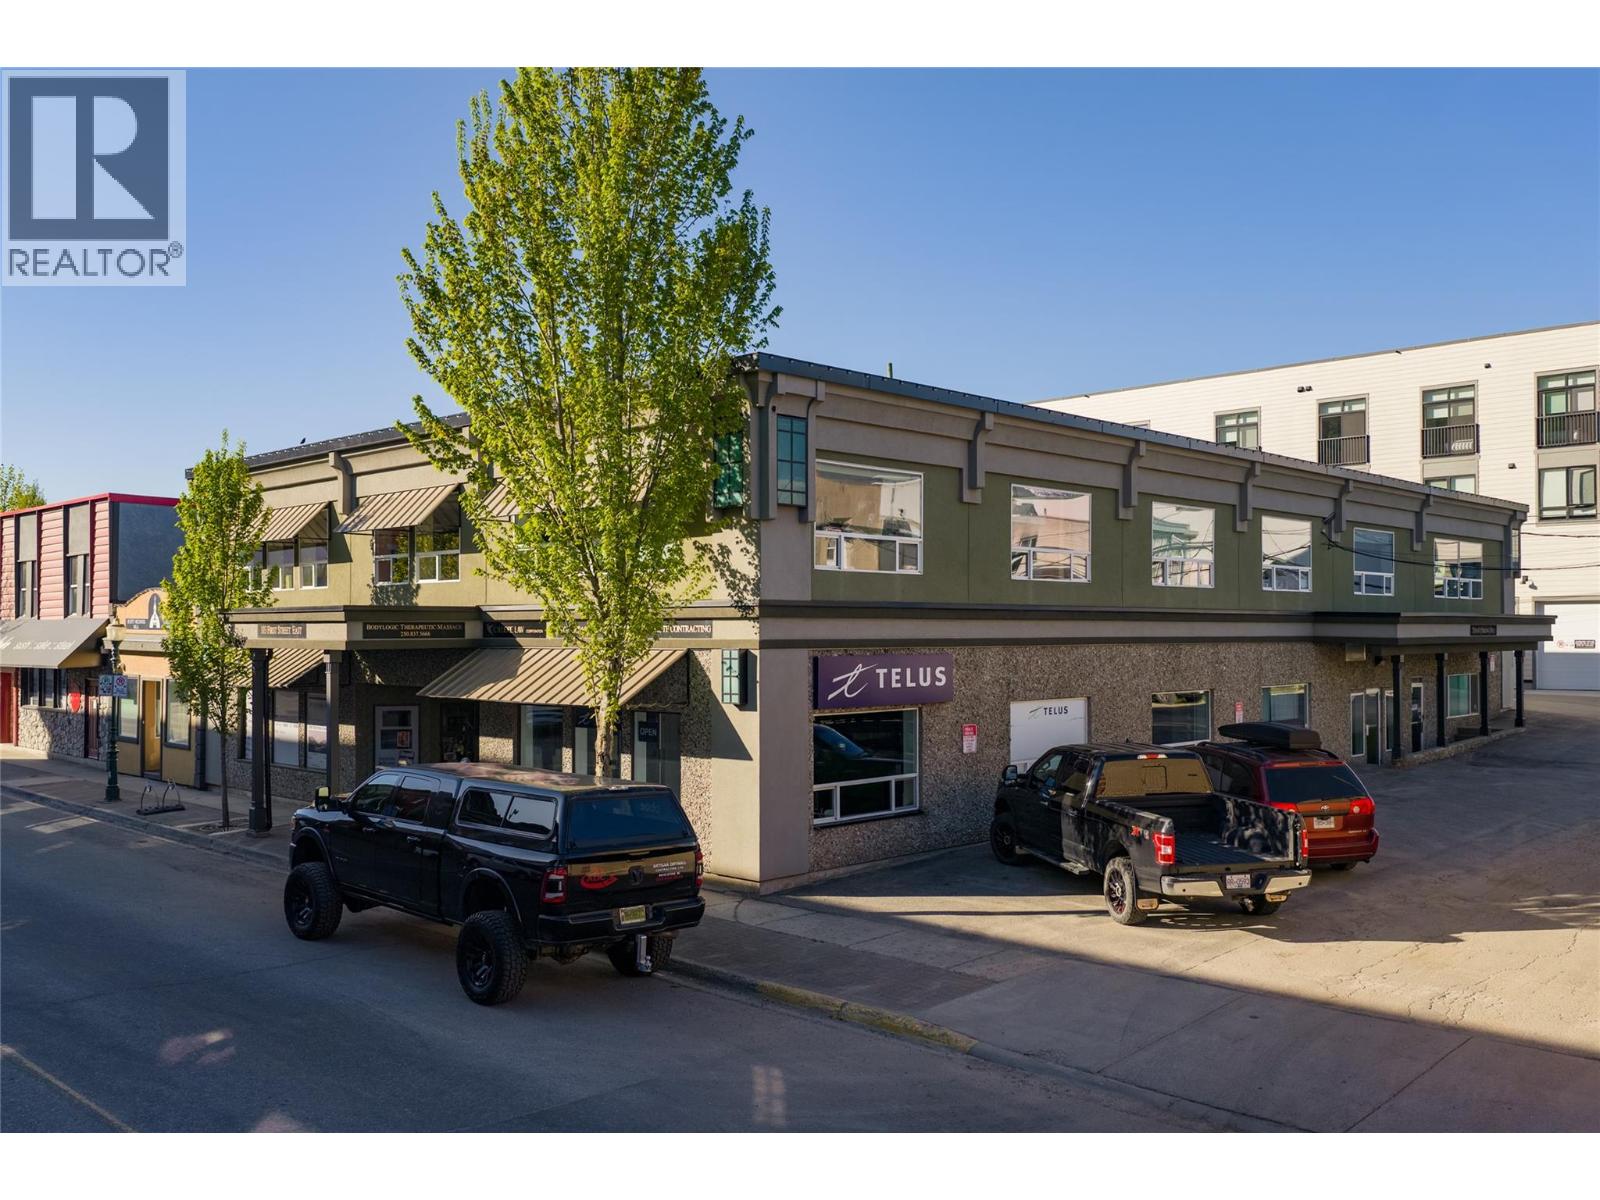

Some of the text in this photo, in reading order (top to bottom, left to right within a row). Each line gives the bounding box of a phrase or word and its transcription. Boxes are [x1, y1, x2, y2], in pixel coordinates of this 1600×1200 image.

[670, 624, 712, 633] CONTRACTING
[875, 666, 947, 688] TELUS
[1043, 705, 1069, 716] TELUS
[640, 727, 657, 737] OPEN
